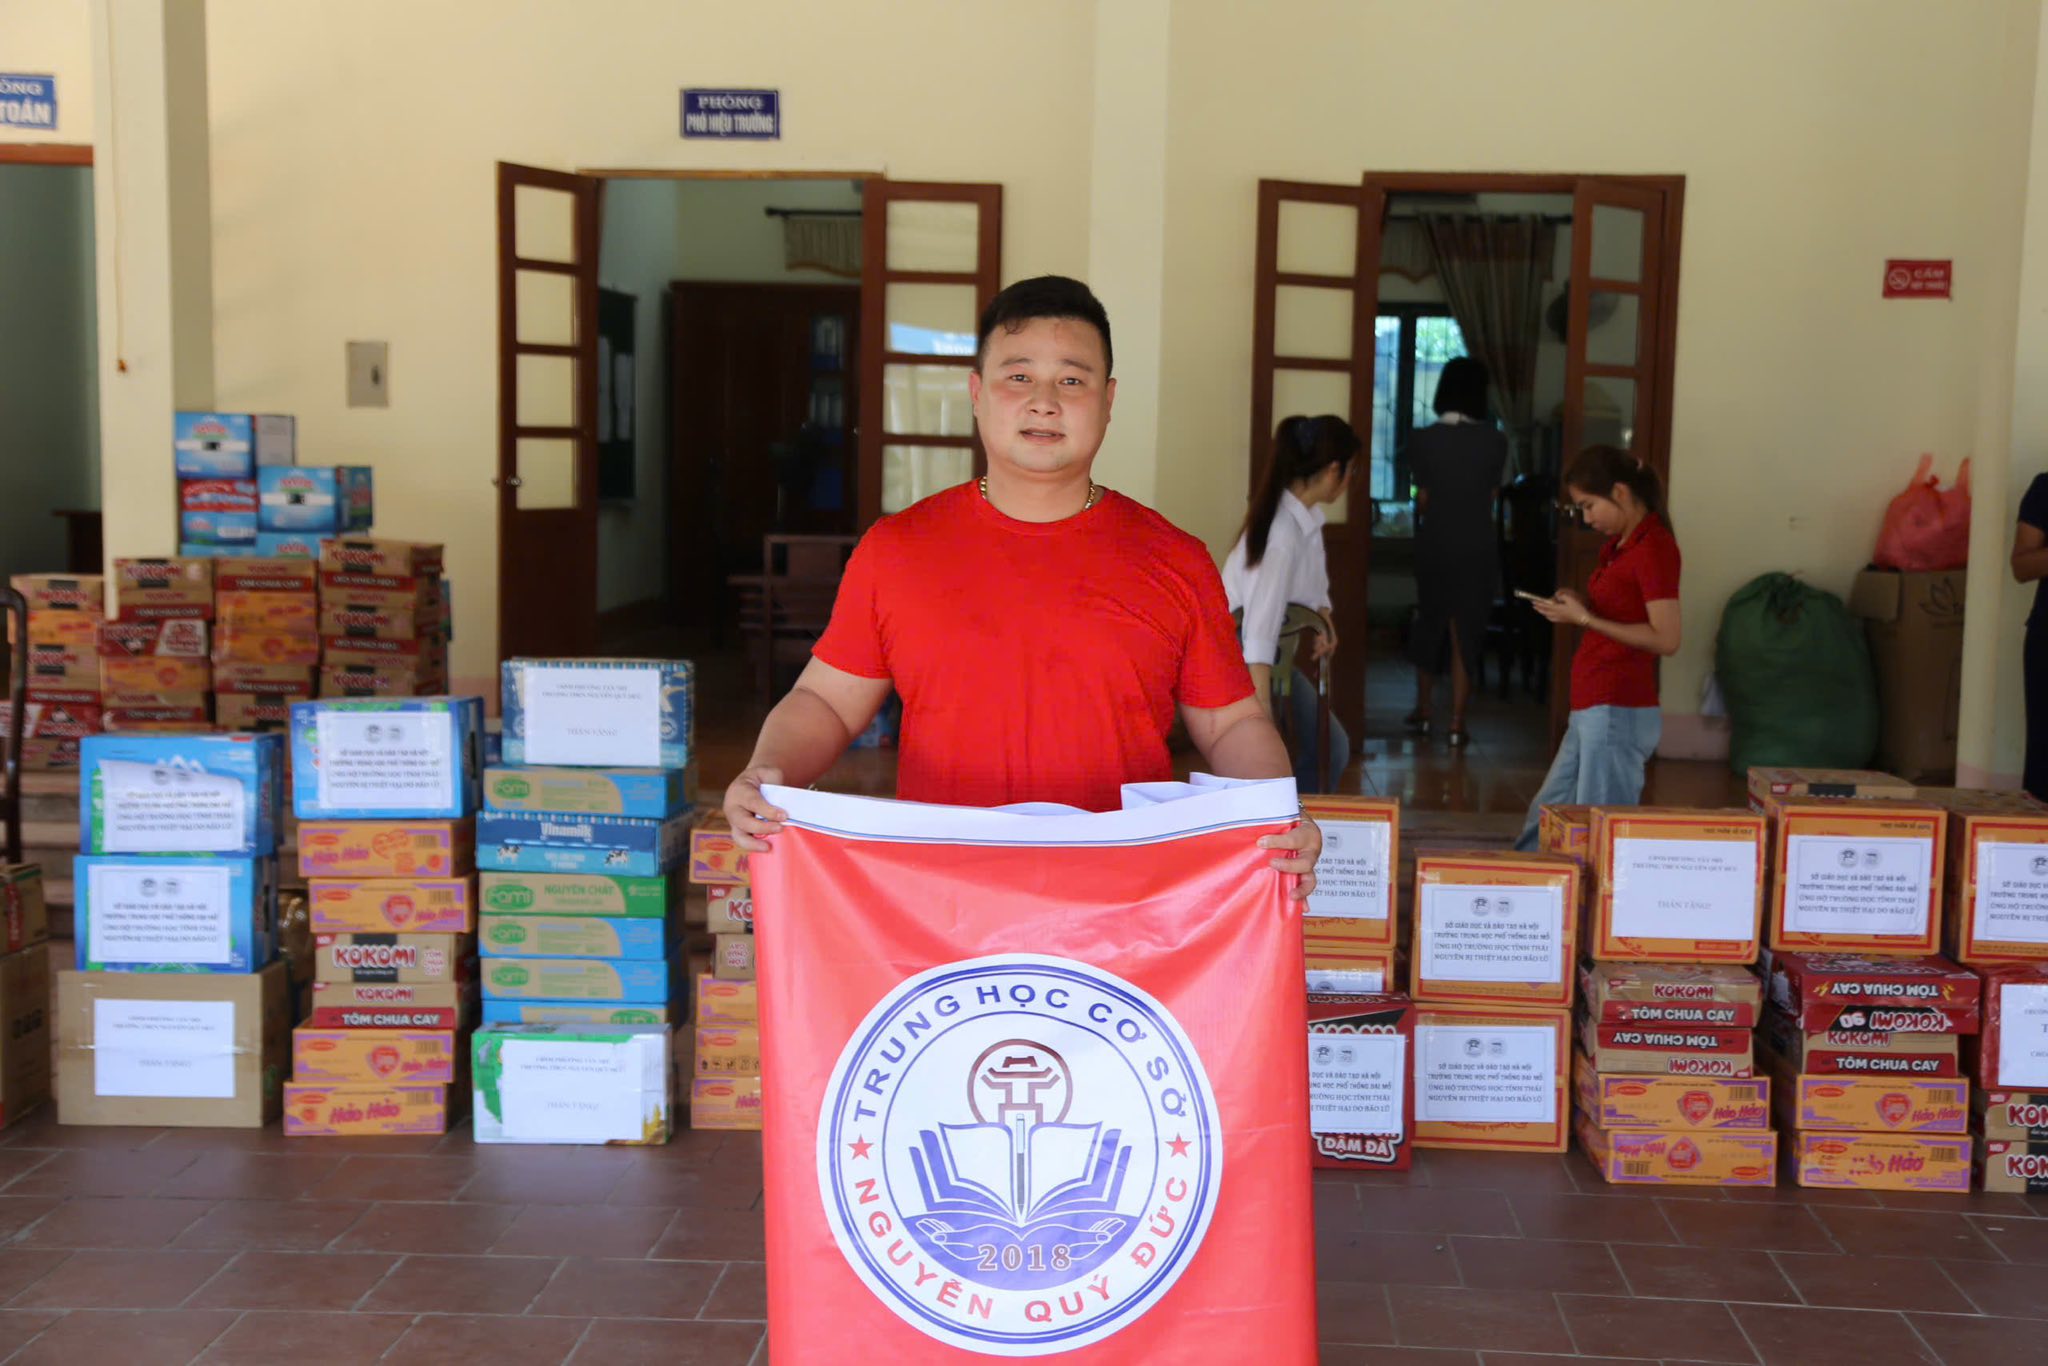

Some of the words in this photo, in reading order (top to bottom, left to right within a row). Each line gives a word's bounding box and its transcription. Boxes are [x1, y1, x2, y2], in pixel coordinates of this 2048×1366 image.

[0, 79, 43, 96] ÒNG
[698, 94, 764, 109] PHÒNG
[541, 822, 593, 840] Vinamilk
[333, 944, 416, 968] KOKOMI
[355, 986, 414, 1001] KOKOMI
[1653, 984, 1715, 998] KOKOMI
[1831, 982, 1860, 994] CAY
[1863, 983, 1903, 996] CHUA
[1907, 984, 1938, 997] TÔM
[342, 1011, 371, 1025] TÔM
[373, 1013, 411, 1025] CHUA
[413, 1013, 440, 1025] CAY
[1631, 1006, 1661, 1019] TÔM
[1664, 1009, 1703, 1020] CHUA
[1706, 1010, 1734, 1021] CAY
[1869, 1011, 1947, 1031] KOKOMI
[1613, 1032, 1642, 1043] CAY
[1644, 1034, 1684, 1046] CHUA
[1687, 1037, 1718, 1049] TÔM
[1826, 1031, 1890, 1046] KOKOMI
[853, 994, 960, 1122] TRUNG
[976, 984, 1069, 1008] HỌC
[1088, 1002, 1147, 1043] CƠ
[1146, 1055, 1187, 1117] SỞ
[1669, 1058, 1733, 1074] KOKOMI
[1836, 1056, 1867, 1069] TÔM
[1869, 1058, 1908, 1071] CHUA
[1911, 1060, 1939, 1072] CAY
[2007, 1104, 2048, 1127] KOK
[1325, 1135, 1361, 1153] ĐẬM
[1365, 1138, 1389, 1156] ĐÀ
[1888, 1151, 1925, 1174] Hảo
[2006, 1155, 2048, 1178] KOK
[855, 1178, 994, 1320] NGUYỄN
[1024, 1274, 1111, 1323] QUÝ
[1130, 1176, 1188, 1269] ĐỨC
[977, 1243, 1072, 1272] 2018
